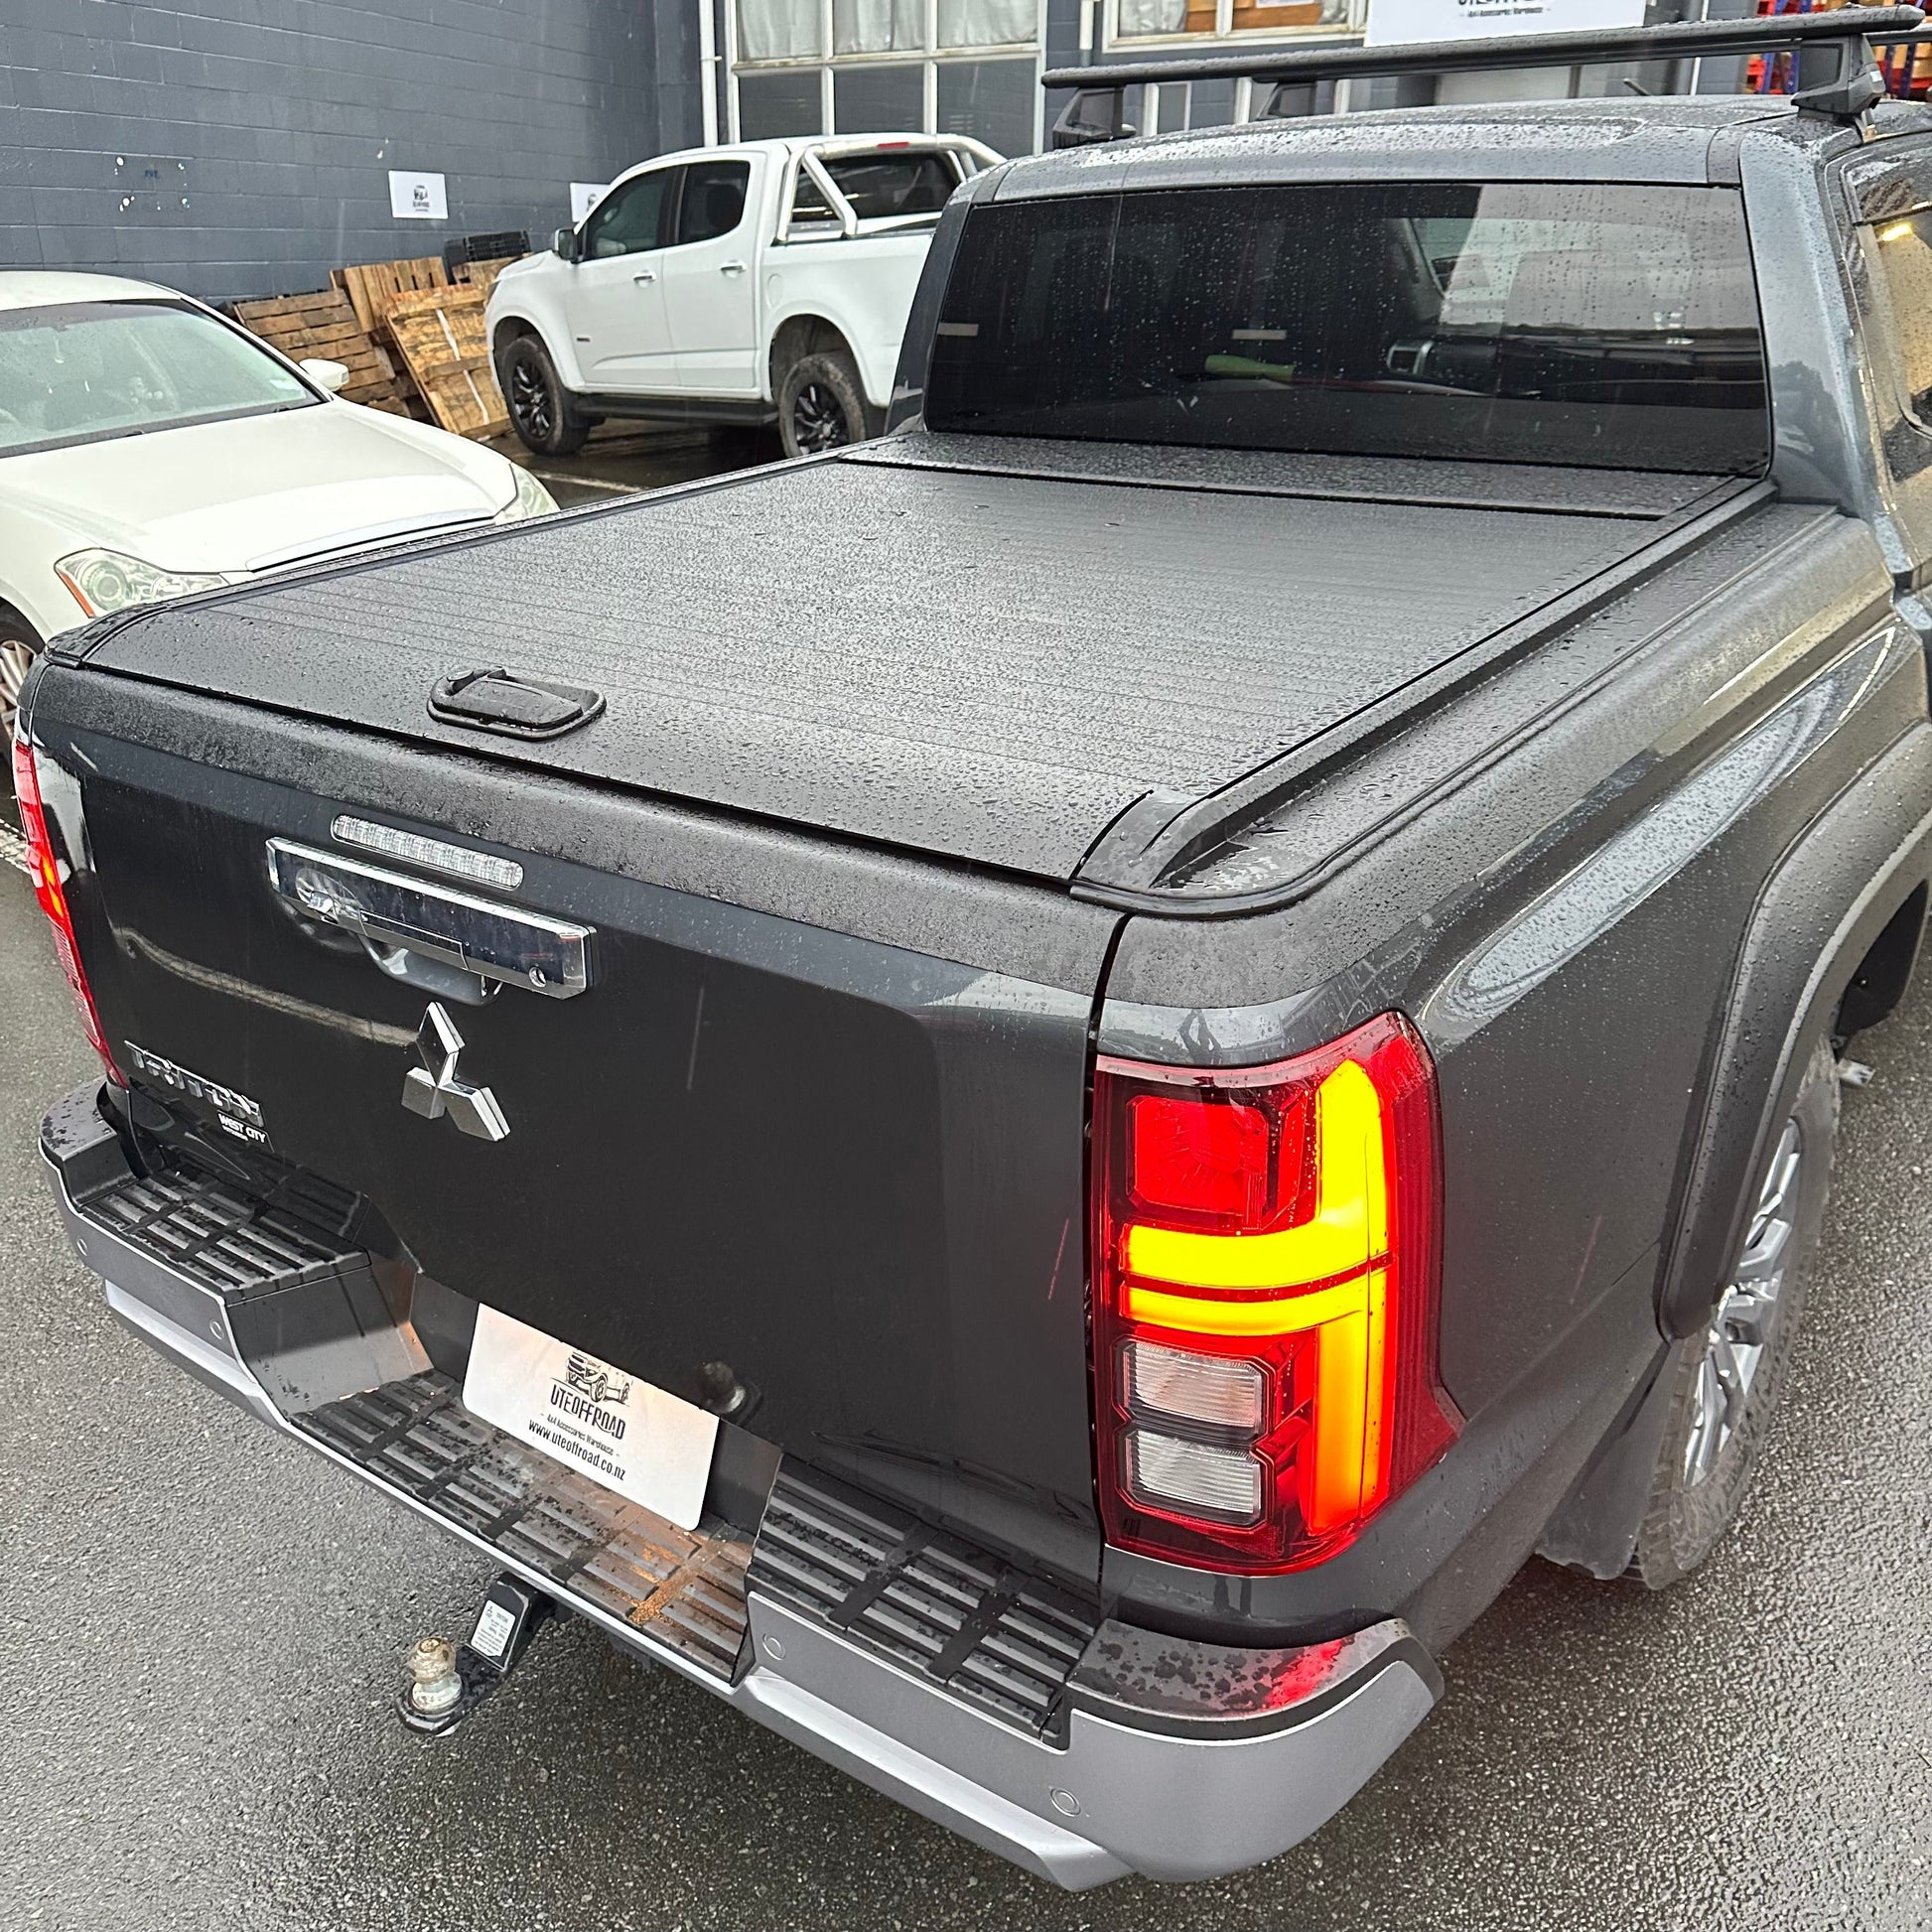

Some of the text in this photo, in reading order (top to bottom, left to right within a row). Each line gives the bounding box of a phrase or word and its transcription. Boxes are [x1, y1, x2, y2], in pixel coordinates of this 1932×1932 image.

[218, 1113, 244, 1133] WEST
[245, 1127, 266, 1143] CITY
[529, 1420, 625, 1480] www.uteoffroad.co.nz
